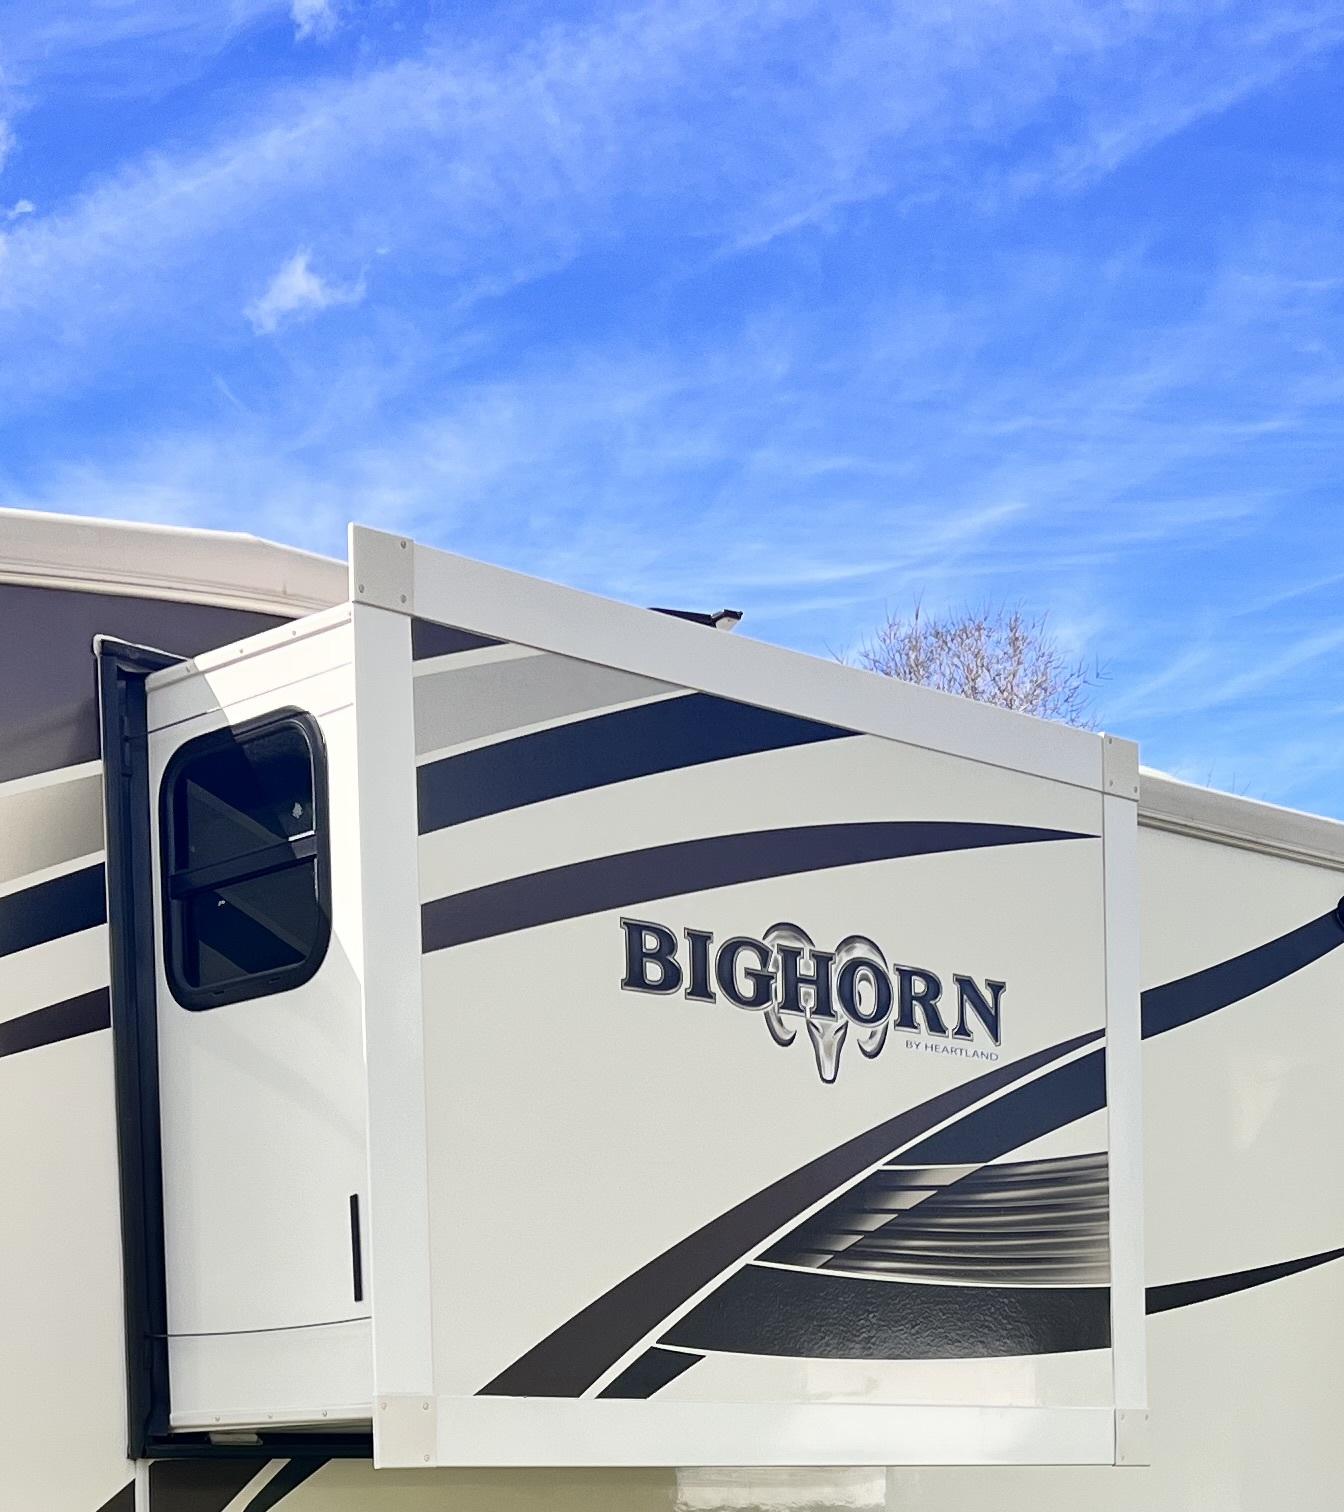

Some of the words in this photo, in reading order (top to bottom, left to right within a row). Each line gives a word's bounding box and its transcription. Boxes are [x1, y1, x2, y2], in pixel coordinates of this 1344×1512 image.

[620, 916, 1007, 1047] BIGHORN
[905, 1039, 921, 1050] BY
[924, 1042, 999, 1061] HEARTLAND
